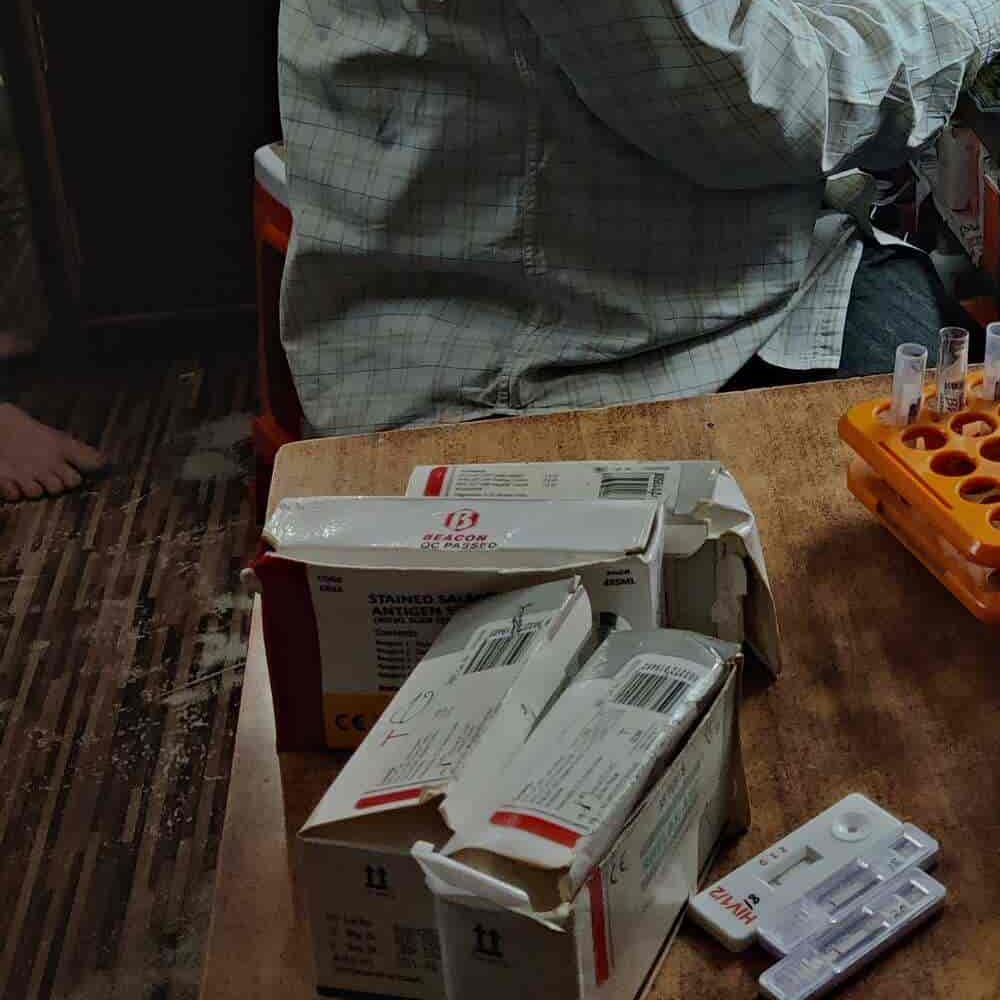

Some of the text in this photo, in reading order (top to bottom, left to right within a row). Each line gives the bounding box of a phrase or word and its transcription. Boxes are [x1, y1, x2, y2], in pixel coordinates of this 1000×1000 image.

[422, 533, 489, 542] BEACON
[420, 541, 498, 550] QC PASSED
[367, 593, 433, 605] STAINED
[371, 606, 442, 617] ANTIGEN
